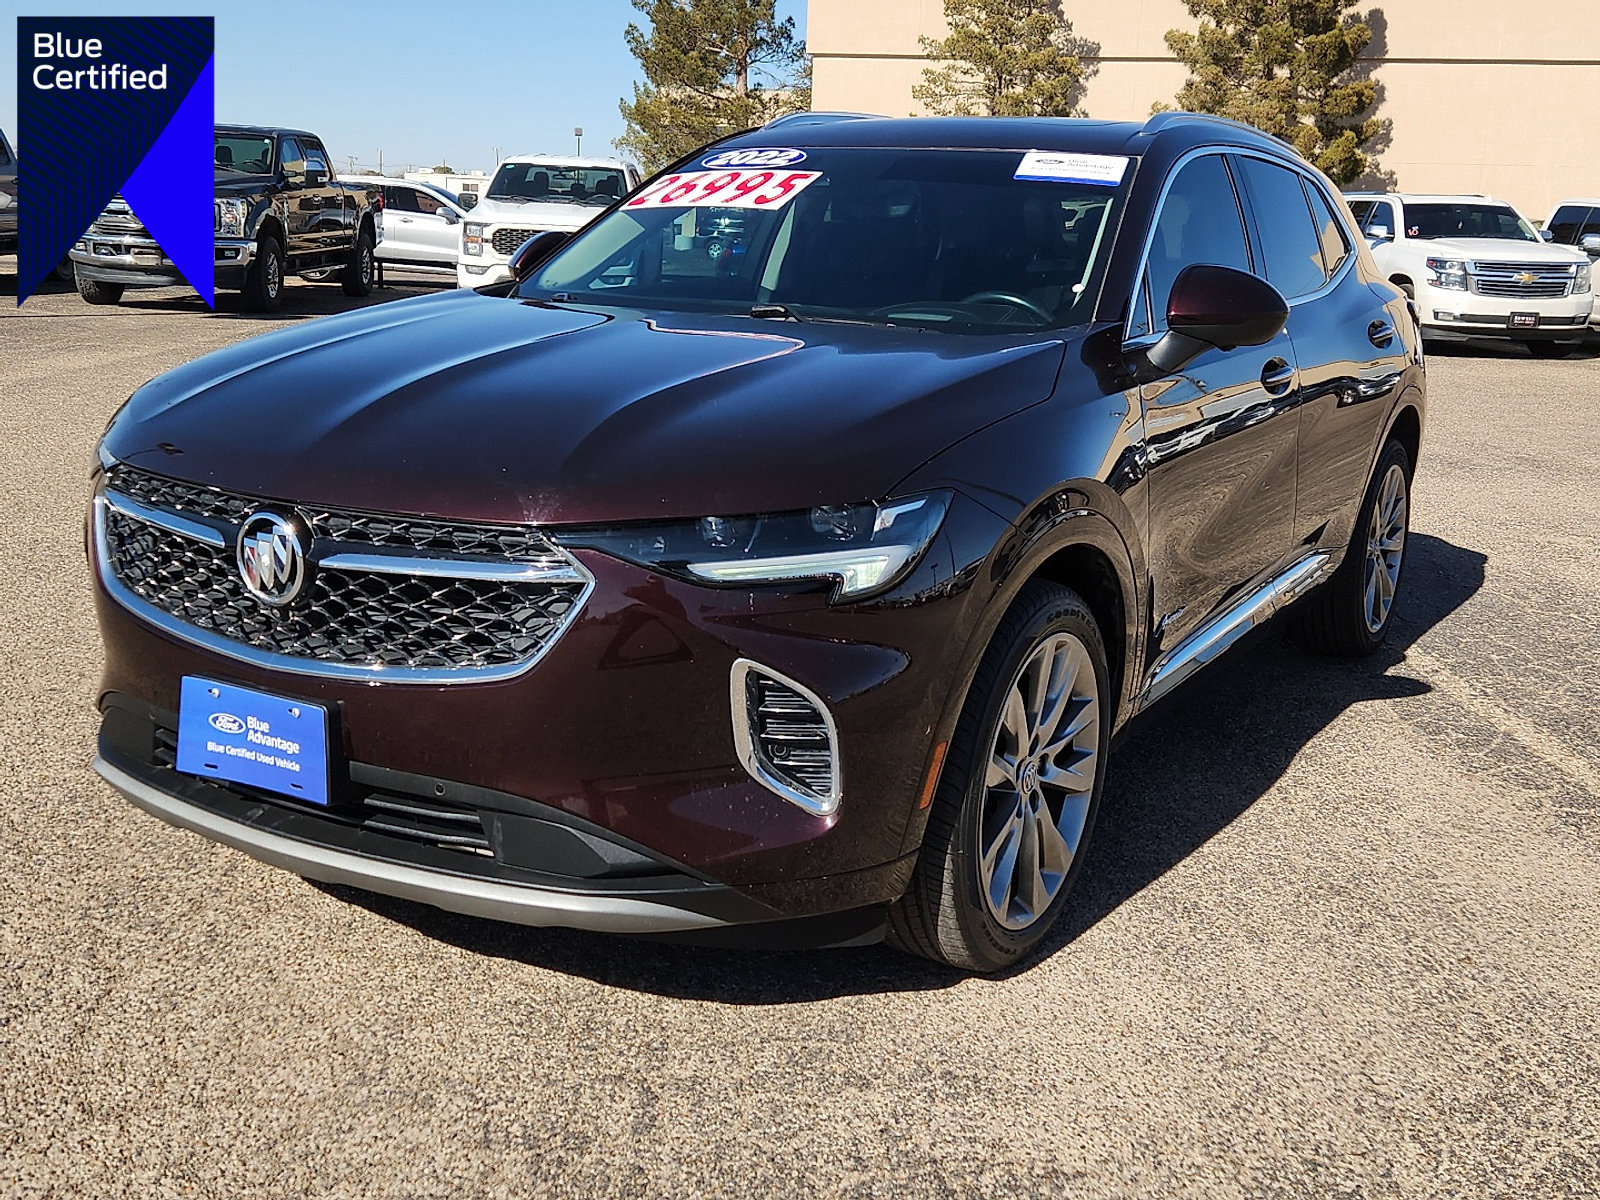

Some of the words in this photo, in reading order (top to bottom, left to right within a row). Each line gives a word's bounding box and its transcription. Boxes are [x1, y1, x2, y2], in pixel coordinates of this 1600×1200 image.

[714, 150, 799, 167] 2022
[626, 171, 817, 207] 26995
[246, 715, 270, 733] Blue
[247, 729, 300, 755] Advantage
[206, 741, 226, 753] Blue
[225, 745, 256, 760] Certified
[256, 752, 275, 766] Used
[275, 756, 301, 772] Vehicle
